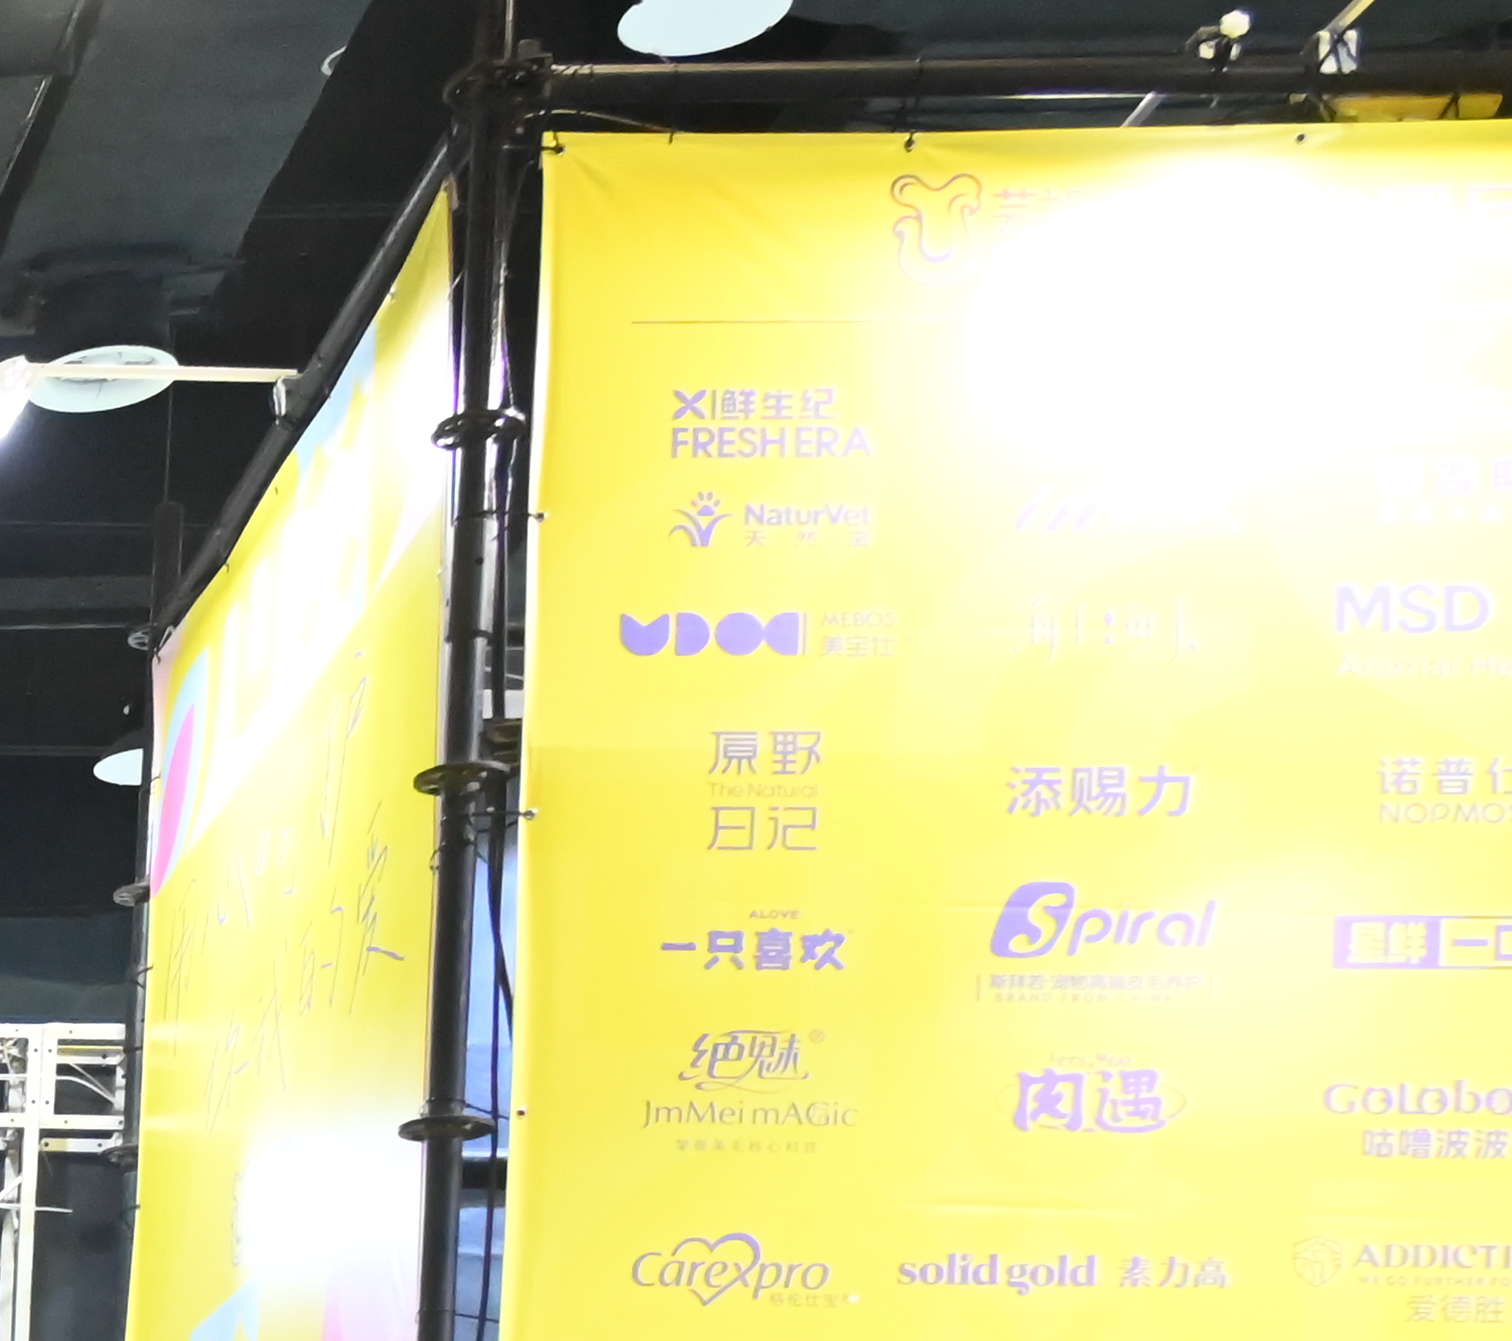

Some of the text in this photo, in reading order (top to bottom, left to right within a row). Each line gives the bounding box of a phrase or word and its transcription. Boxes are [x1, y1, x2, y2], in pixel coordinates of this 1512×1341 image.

[671, 426, 871, 459] FRESH ERA
[744, 504, 871, 526] NaturVet
[820, 611, 896, 628] MEBOS
[1335, 585, 1489, 634] MSD
[819, 635, 895, 657] 美宝仕
[709, 731, 821, 775] 原野
[707, 782, 819, 798] The Natural
[1006, 765, 1193, 818] 添赐力
[707, 806, 819, 851] 日记
[1378, 802, 1512, 825] NOPMO
[749, 910, 799, 920] ALOVE
[991, 881, 1217, 958] Spiral
[660, 929, 847, 971] 一只喜欢
[1013, 1069, 1166, 1133] 肉遇
[897, 1253, 1097, 1296] solid gold
[1118, 1256, 1230, 1290] 素力高
[1406, 1295, 1505, 1323] 爱德胜
